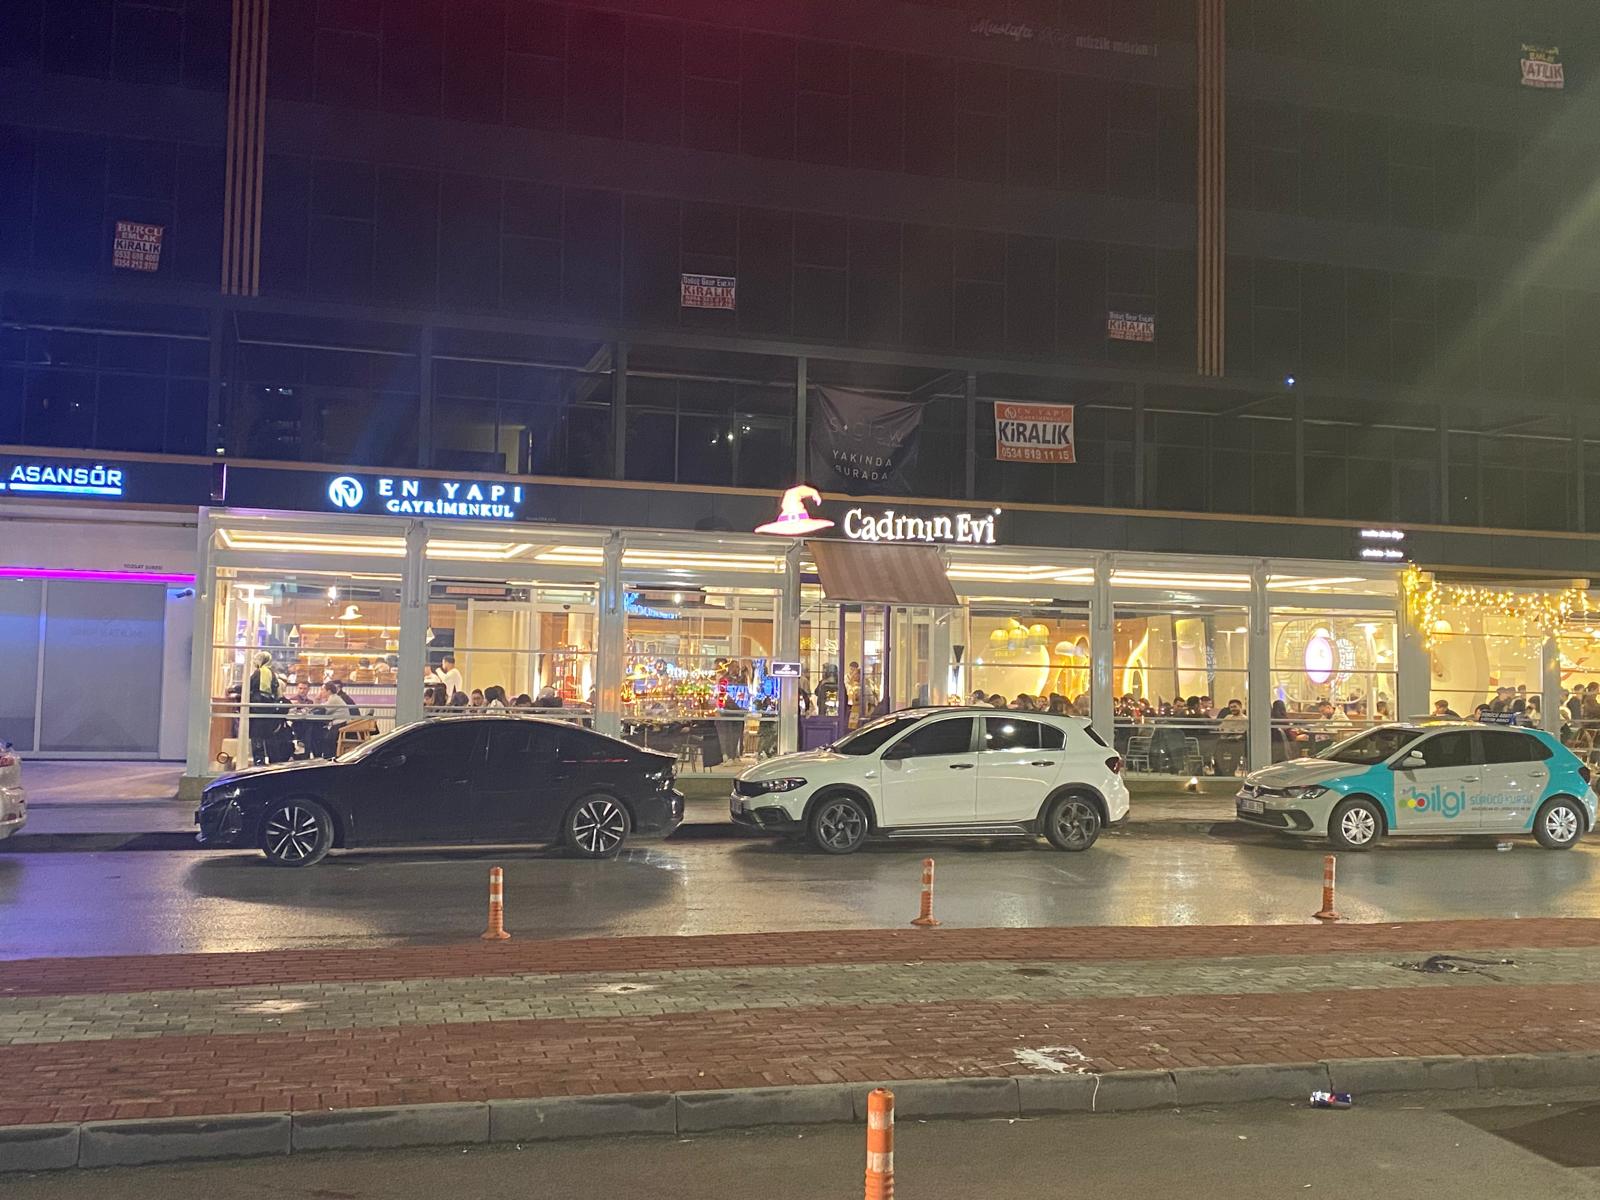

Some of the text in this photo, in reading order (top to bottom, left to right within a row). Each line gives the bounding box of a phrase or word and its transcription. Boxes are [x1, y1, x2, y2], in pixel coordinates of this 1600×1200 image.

[118, 223, 163, 237] BURCU
[122, 232, 157, 242] EMLAK
[832, 449, 892, 468] YAKINDA
[10, 465, 122, 486] ASANSÖR
[379, 479, 522, 503] EN YAPI
[386, 499, 515, 518] GAYRİMENKUL
[956, 510, 997, 544] Evi
[1411, 785, 1466, 819] bilgi
